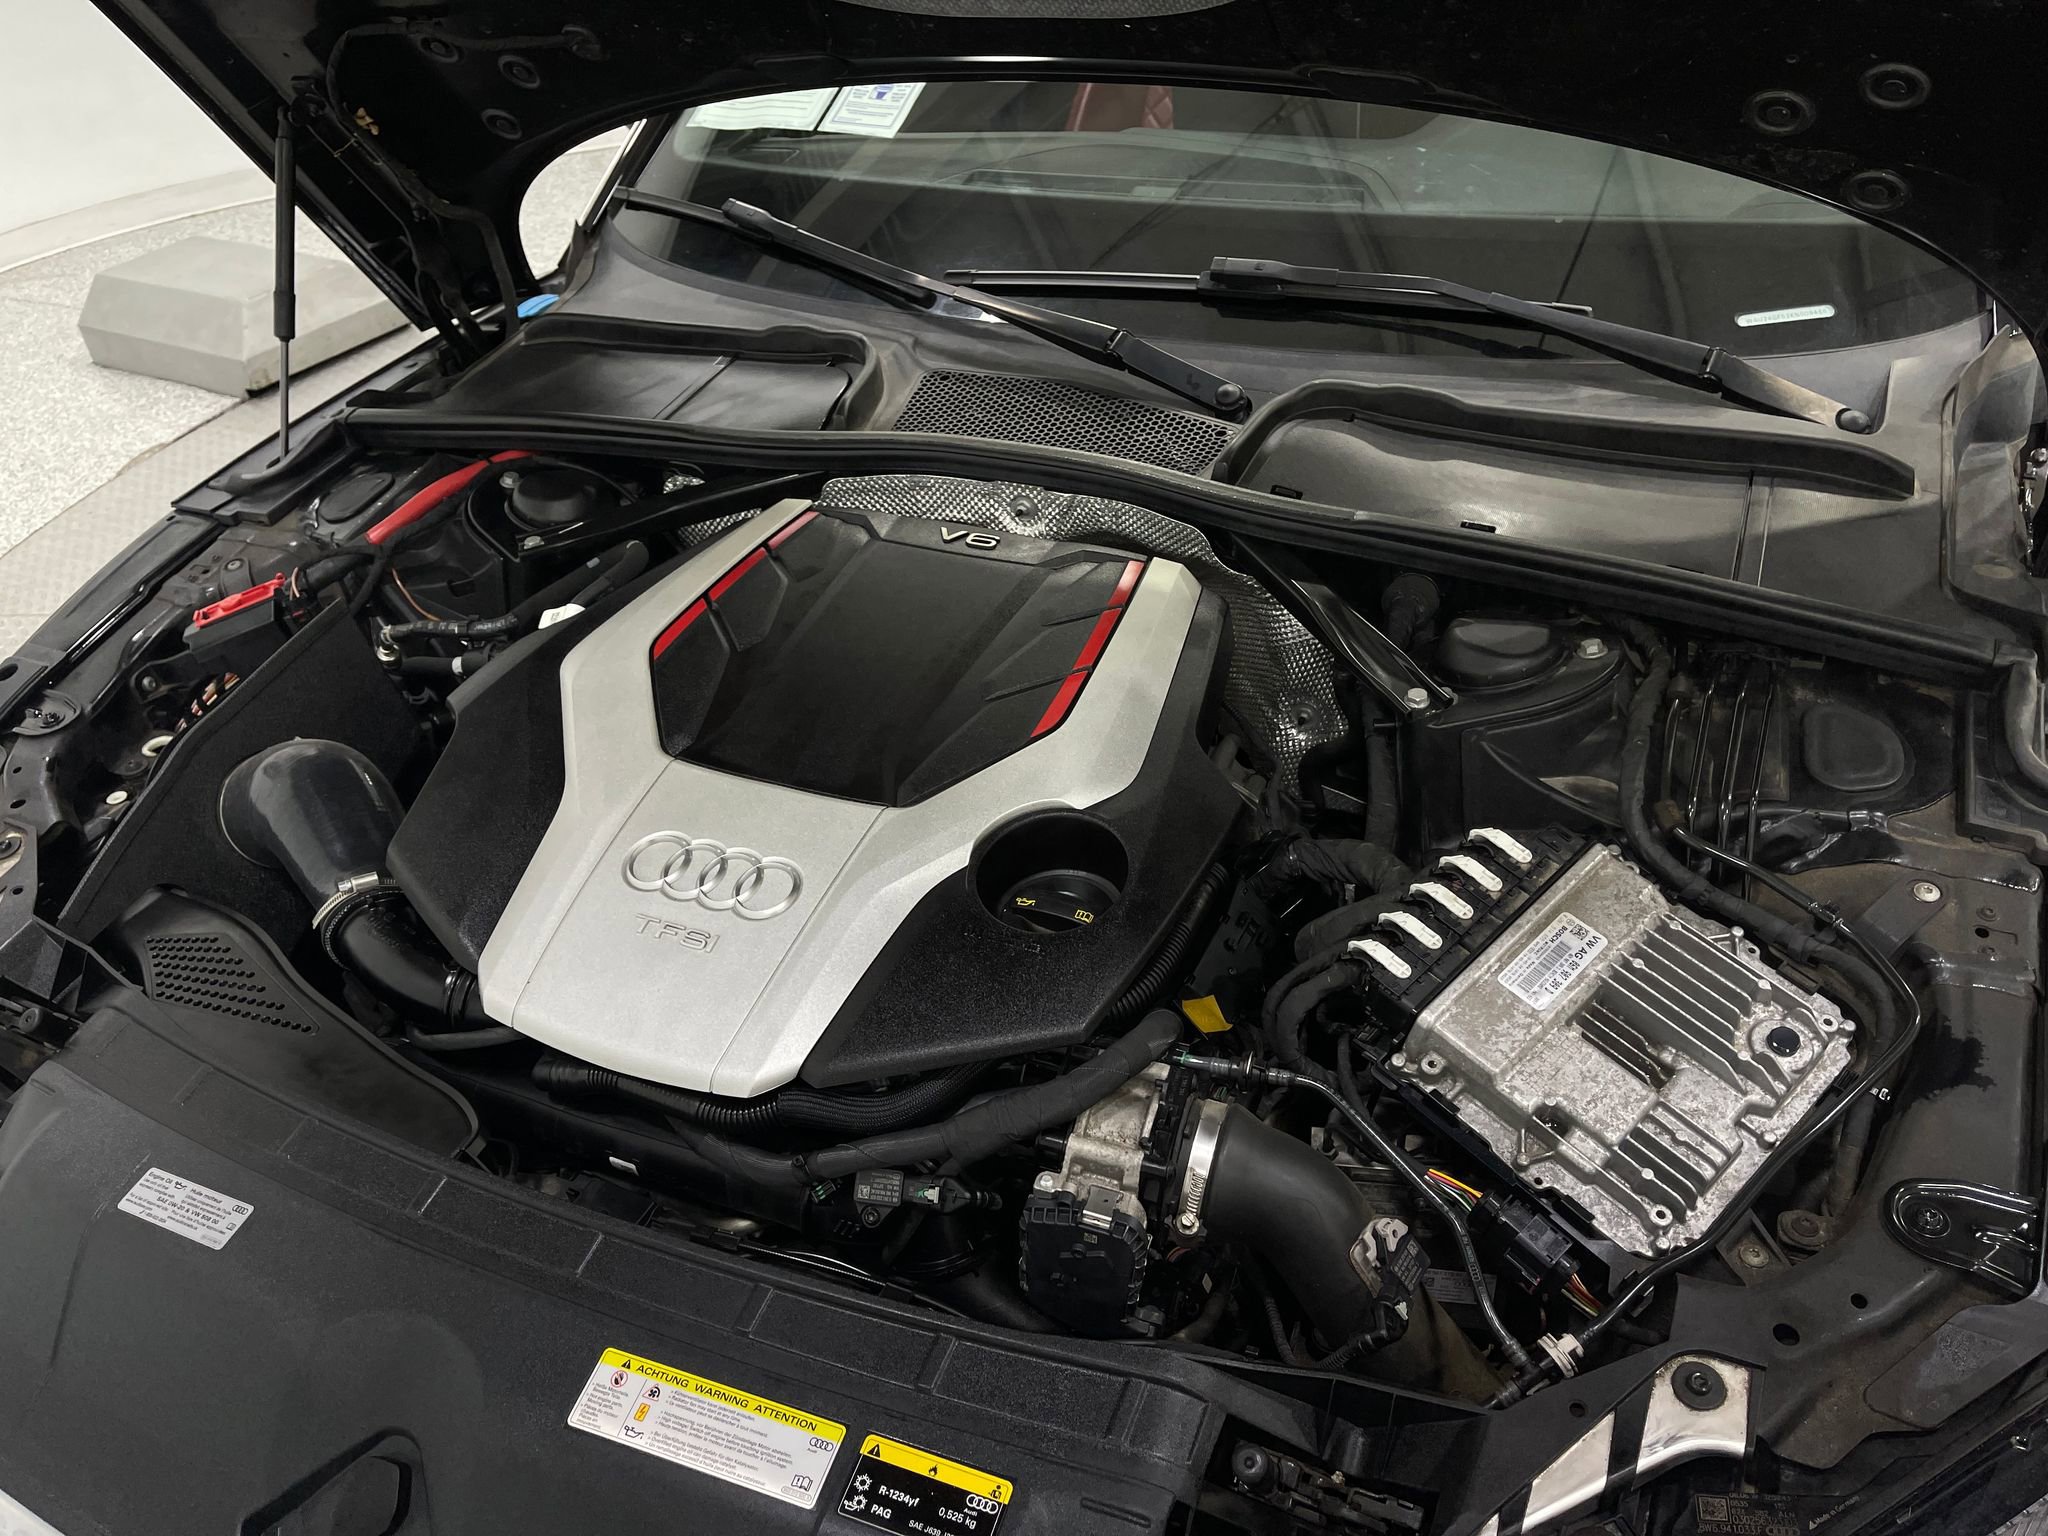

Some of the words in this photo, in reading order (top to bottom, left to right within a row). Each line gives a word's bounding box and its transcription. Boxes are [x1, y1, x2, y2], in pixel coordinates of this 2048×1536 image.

[940, 526, 1000, 550] V6
[634, 912, 721, 953] TFSI
[1549, 926, 1568, 943] BOSCH
[1586, 936, 1601, 949] VW
[1574, 947, 1587, 960] AG
[636, 1365, 689, 1387] ACHTUNG
[695, 1384, 748, 1408] WARNING
[754, 1405, 817, 1431] ATTENTION
[878, 1485, 920, 1507] R-1234yf
[870, 1504, 892, 1519] PAG
[938, 1507, 965, 1524] 0,525
[965, 1516, 977, 1530] kg
[963, 1507, 978, 1517] Audi
[908, 1519, 924, 1531] SAE
